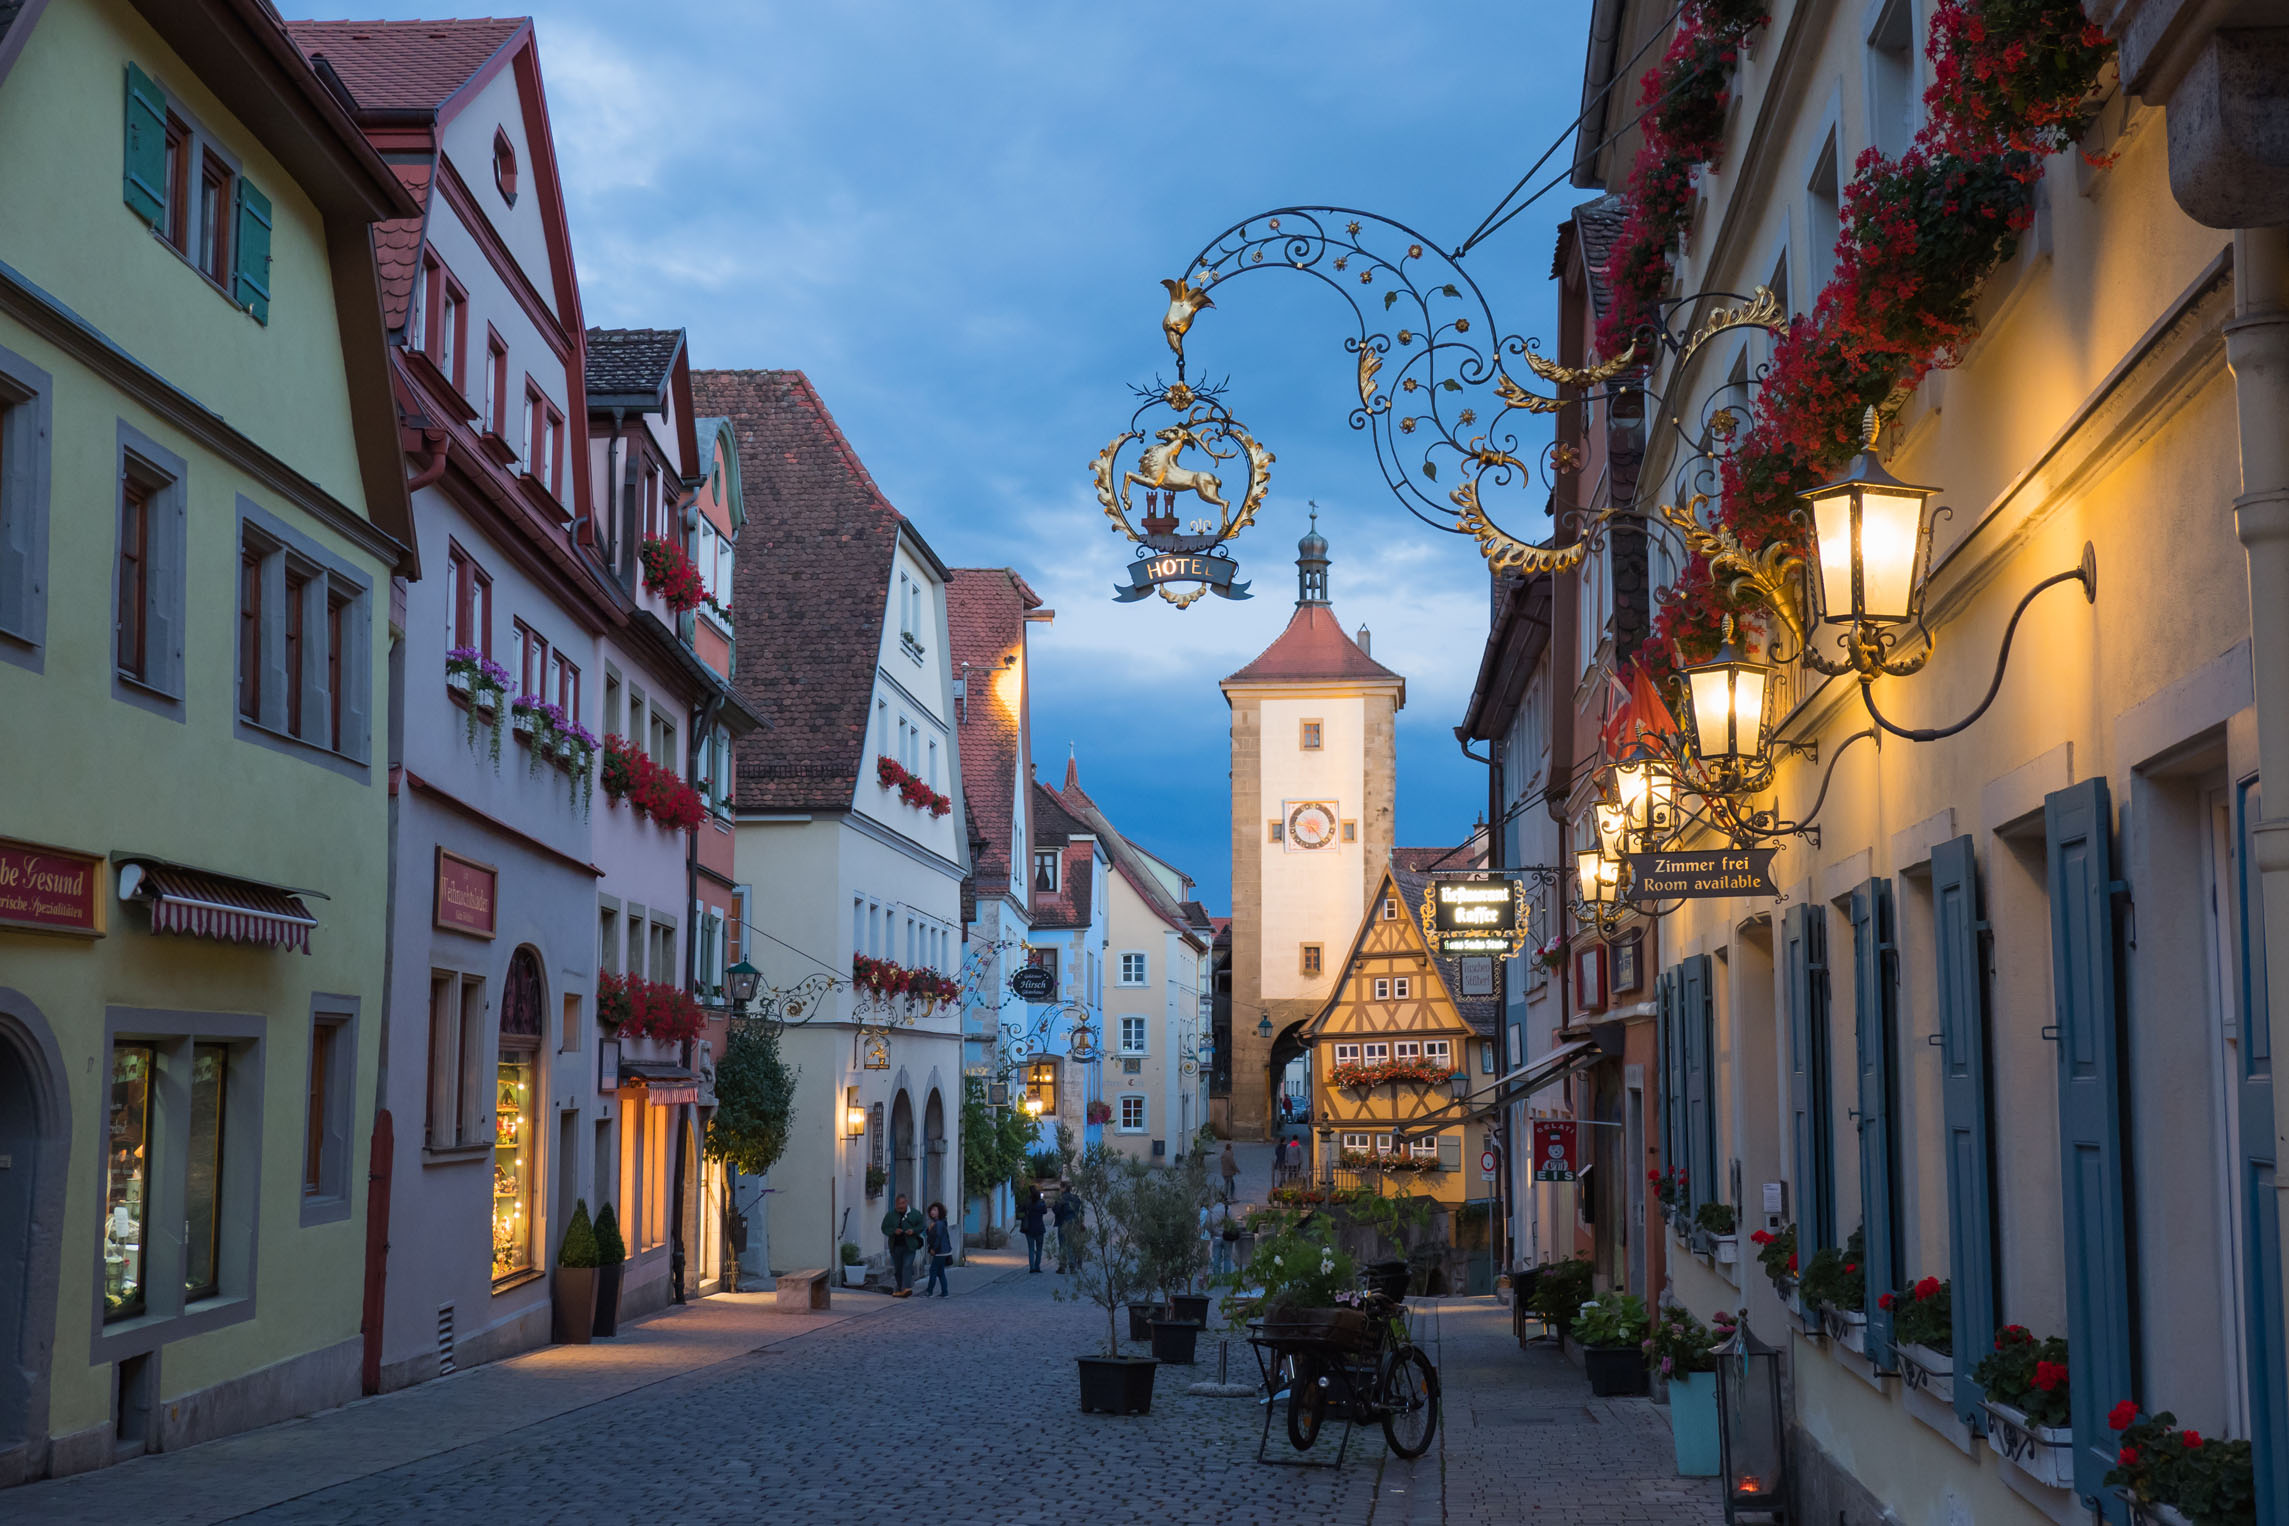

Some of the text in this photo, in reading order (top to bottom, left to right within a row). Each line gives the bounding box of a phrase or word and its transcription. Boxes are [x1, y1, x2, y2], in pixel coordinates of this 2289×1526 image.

[1146, 558, 1214, 580] HOTEL
[1654, 856, 1749, 873] Zimmer frei
[22, 856, 84, 896] Gesund
[1643, 875, 1761, 892] Room available
[1020, 979, 1046, 988] Hirsch
[1536, 1123, 1575, 1134] GELATI
[1536, 1171, 1574, 1180] EIS
